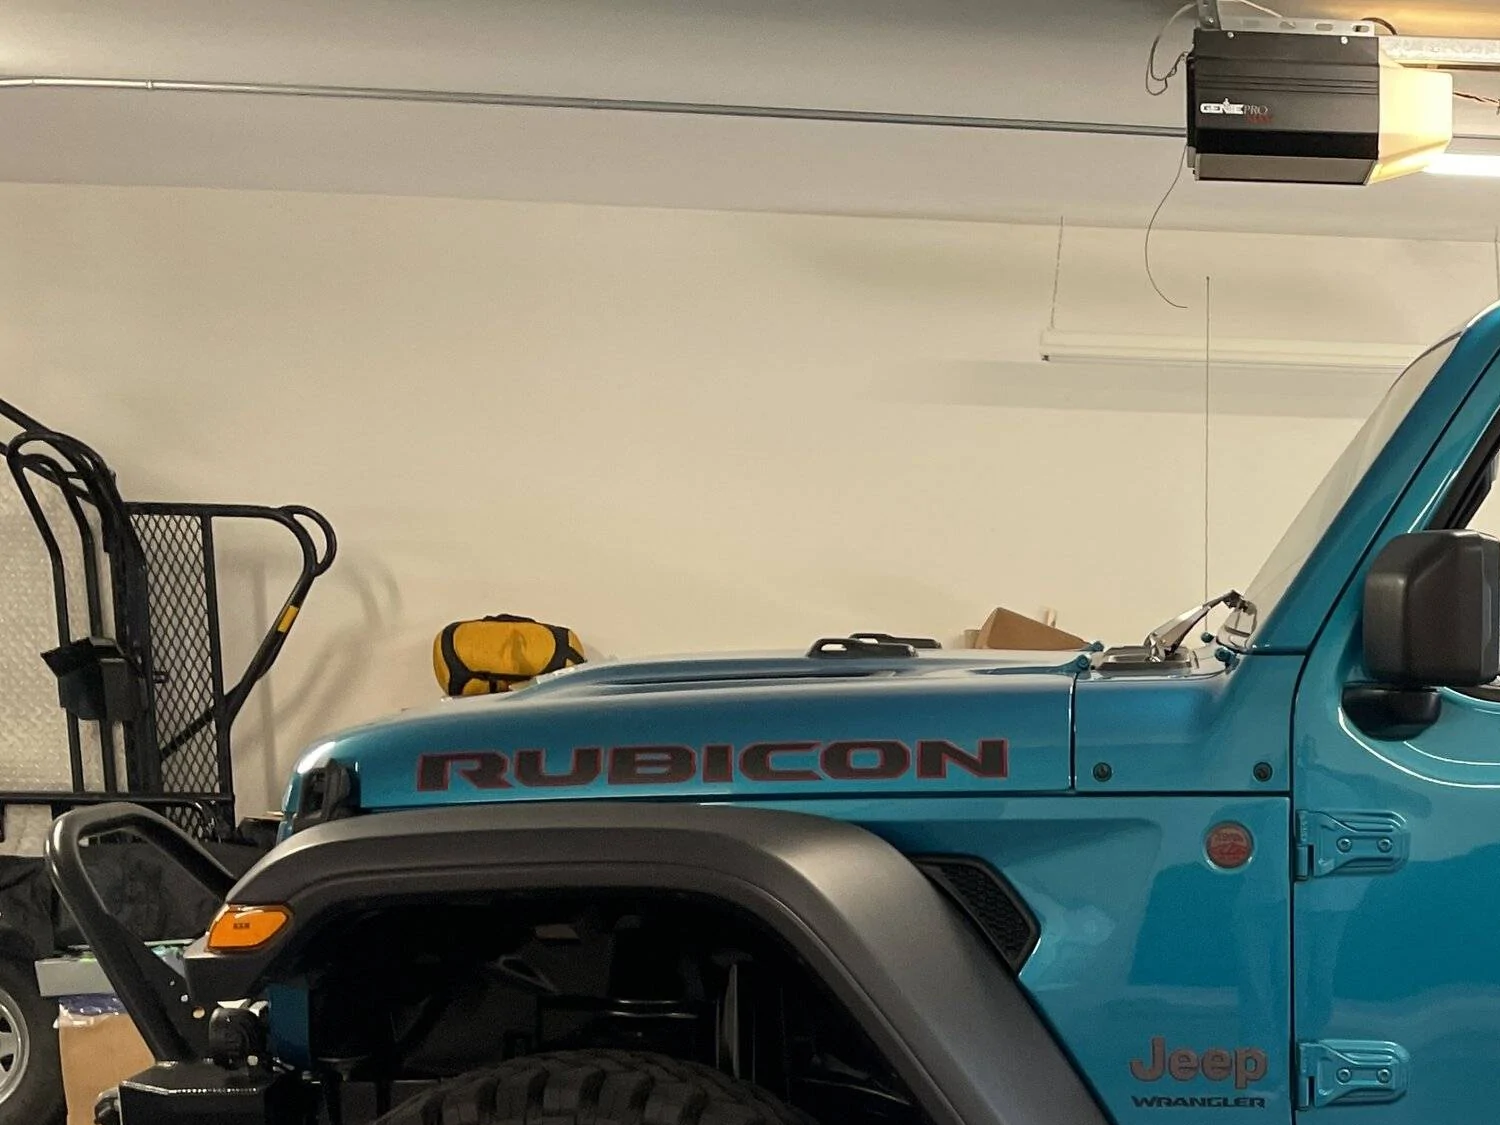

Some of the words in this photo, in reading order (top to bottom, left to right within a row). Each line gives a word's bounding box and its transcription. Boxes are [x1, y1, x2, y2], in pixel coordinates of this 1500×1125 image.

[417, 739, 1009, 792] RUBICON
[1129, 1036, 1268, 1090] Jeep
[1131, 1095, 1266, 1109] WRANGLER
